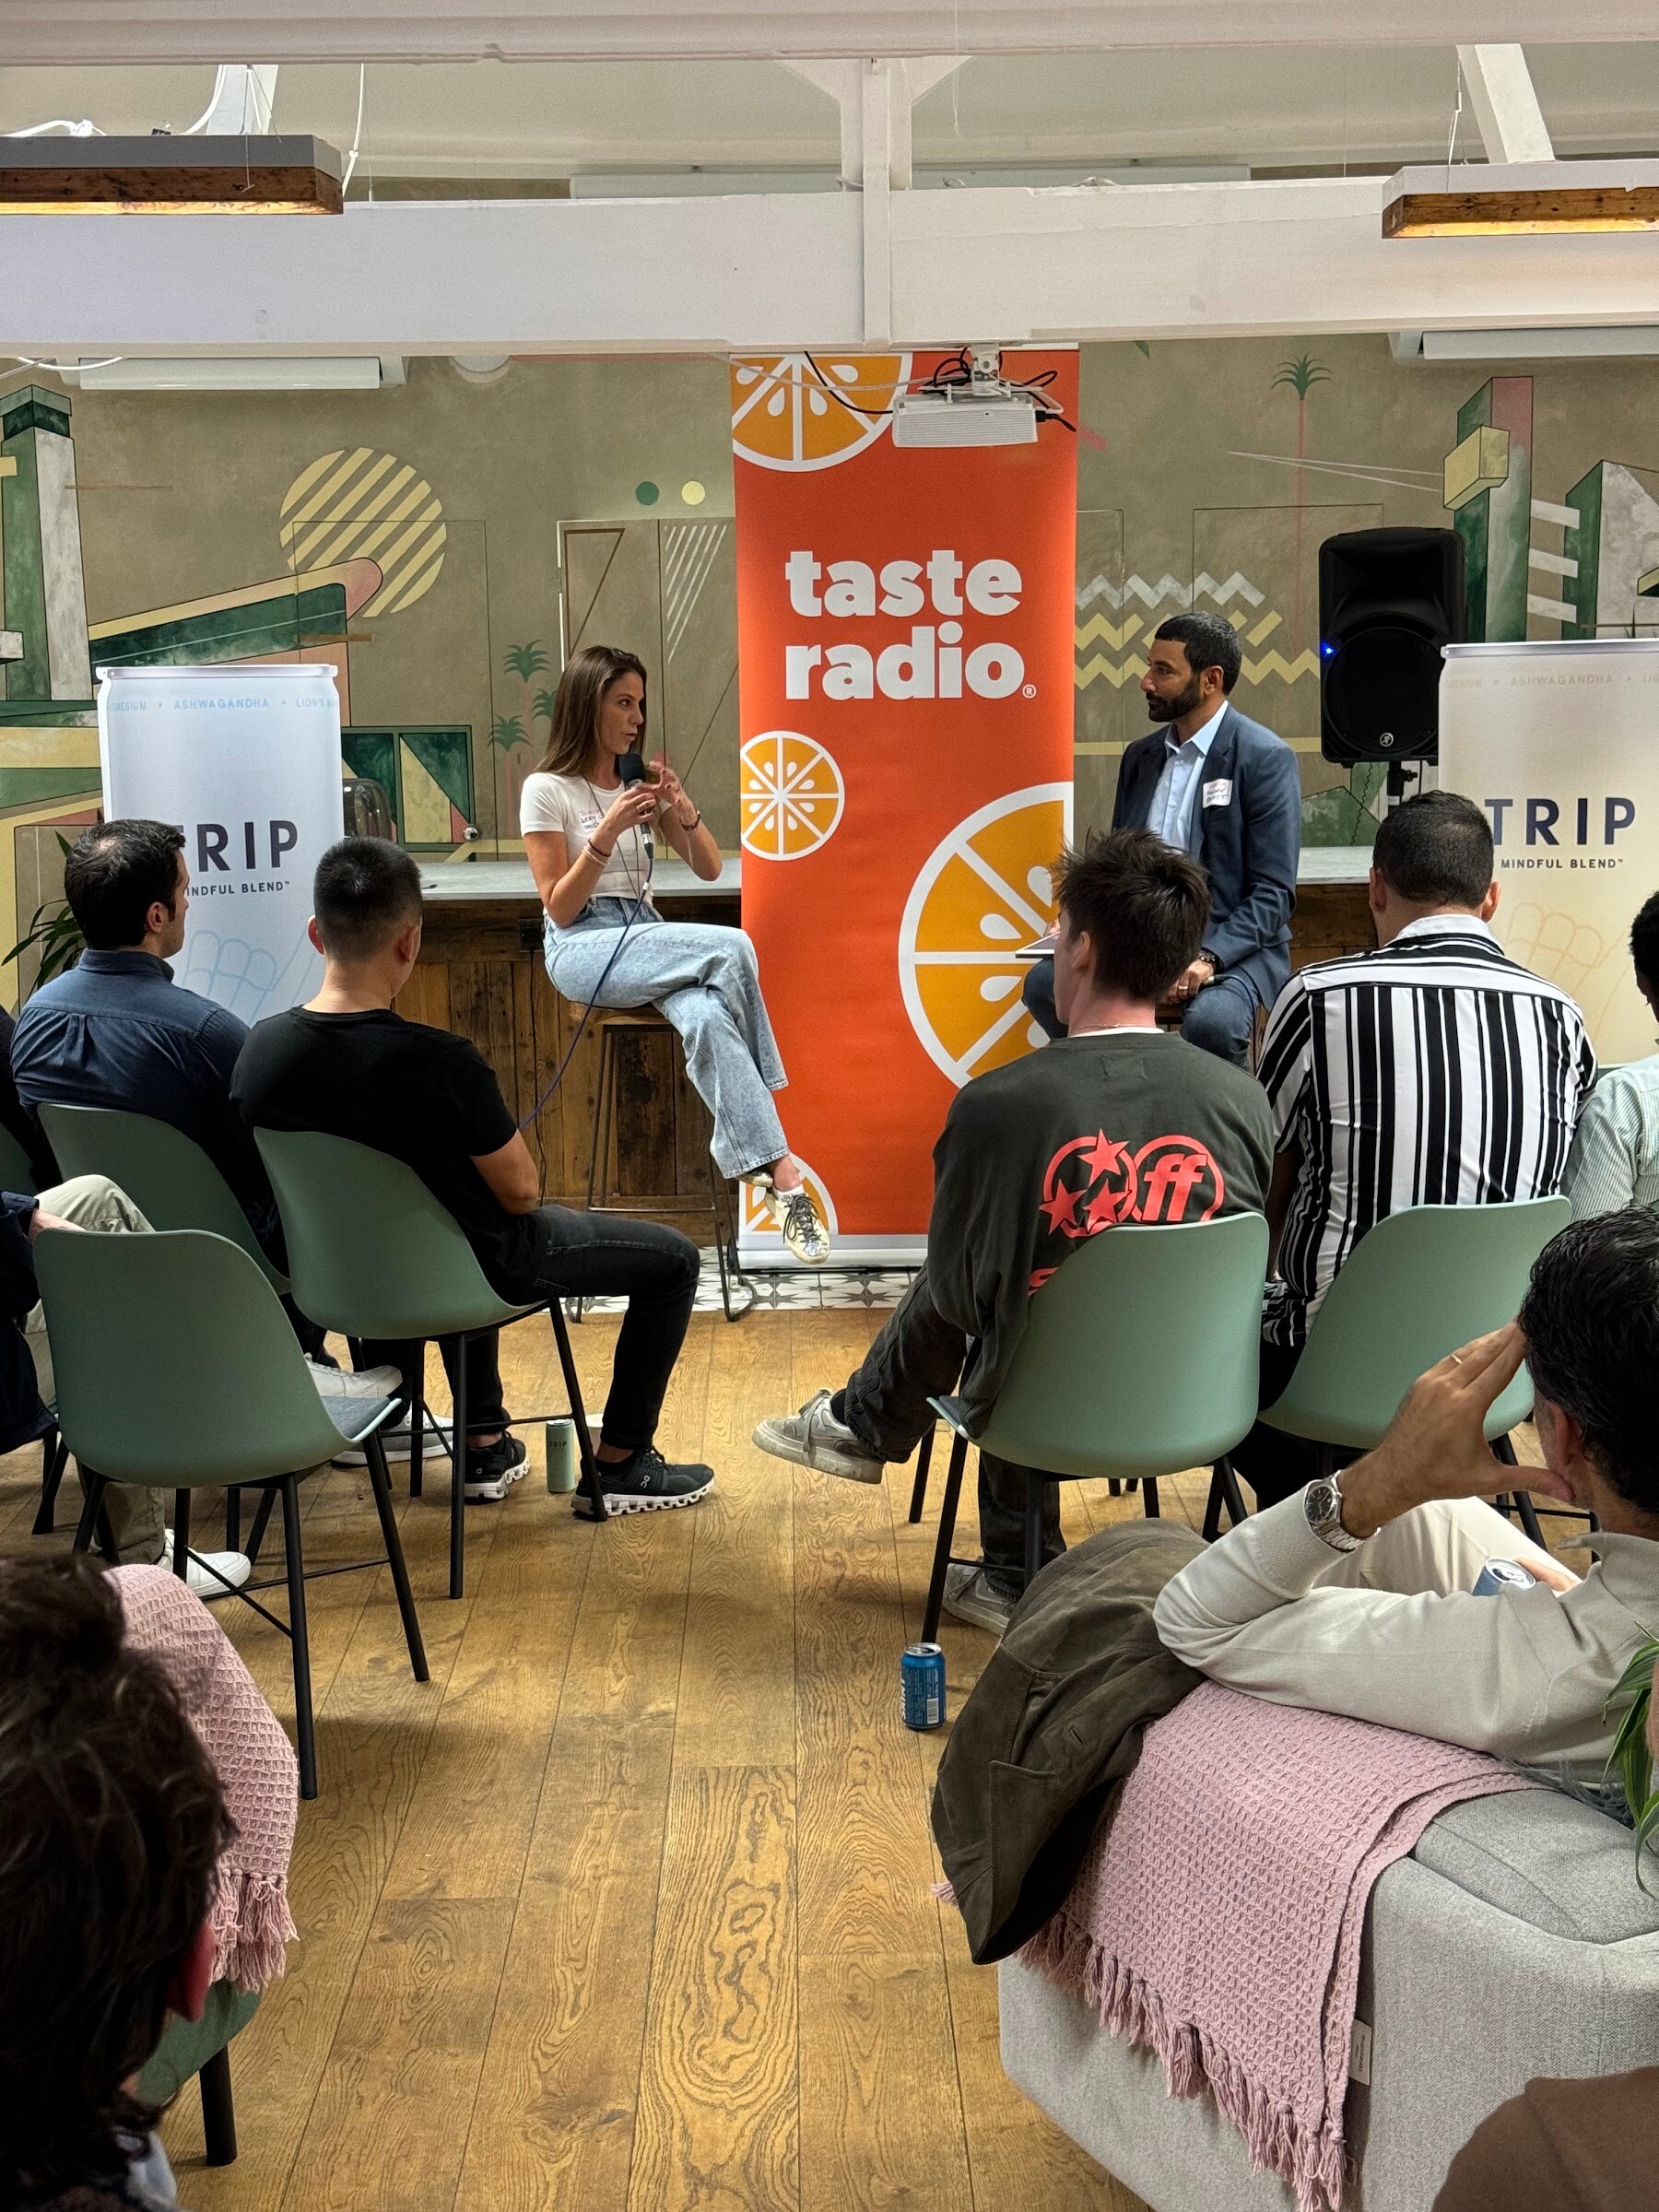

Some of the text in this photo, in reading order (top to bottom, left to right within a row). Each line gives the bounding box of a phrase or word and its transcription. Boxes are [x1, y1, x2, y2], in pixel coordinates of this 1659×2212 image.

[785, 549, 1022, 618] taste
[1510, 674, 1614, 687] ASHWAGANDHA
[173, 699, 270, 710] ASHWAGANDHA
[1484, 797, 1636, 846] TRIP
[174, 819, 298, 873] RIP
[1500, 858, 1563, 868] MINDFUL
[186, 885, 235, 897] INDFUL
